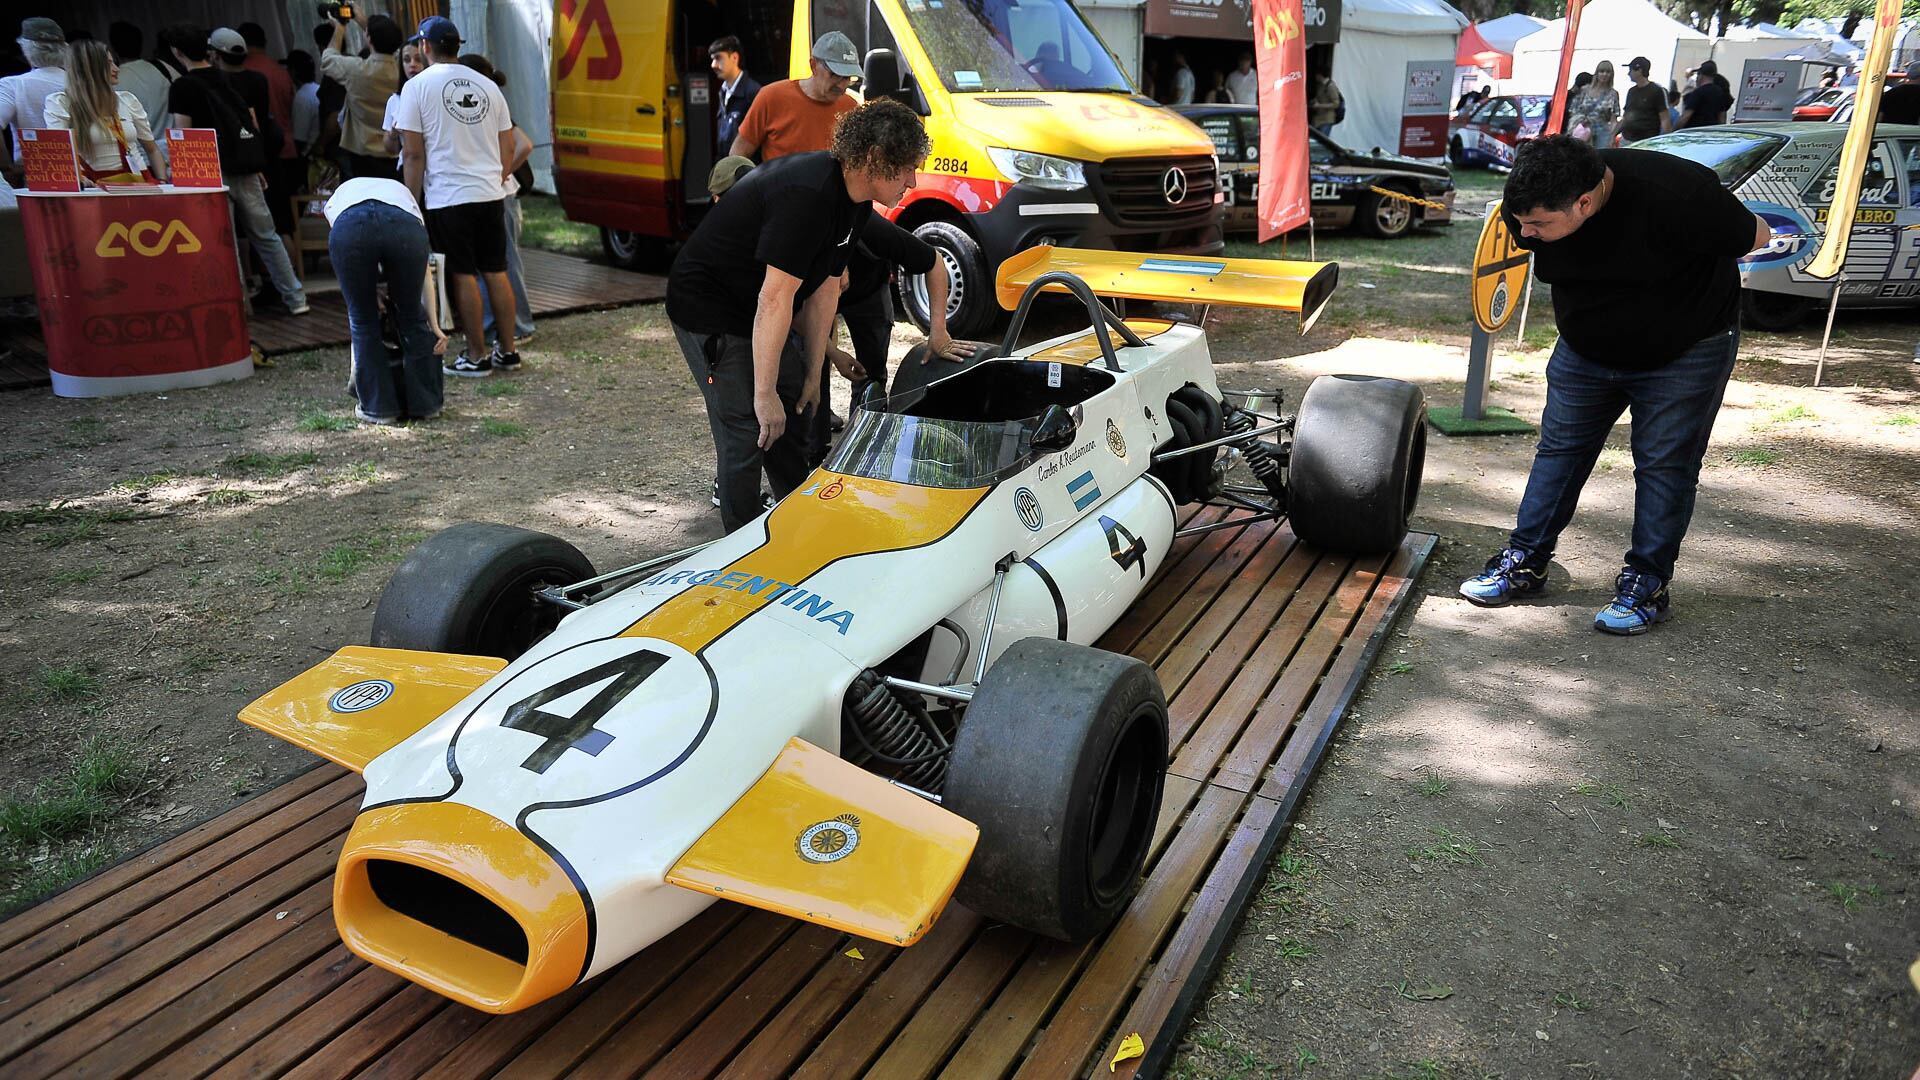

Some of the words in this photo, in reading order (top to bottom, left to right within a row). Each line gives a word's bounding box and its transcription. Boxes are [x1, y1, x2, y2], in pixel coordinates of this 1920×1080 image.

[933, 157, 969, 175] 2884
[95, 219, 202, 258] ACA
[1037, 461, 1059, 482] Carlos
[824, 484, 839, 498] E
[1018, 494, 1040, 525] YPF
[1098, 514, 1148, 581] 4
[641, 568, 855, 636] ARGENTINA
[341, 685, 384, 708] YPF
[499, 648, 672, 776] 4
